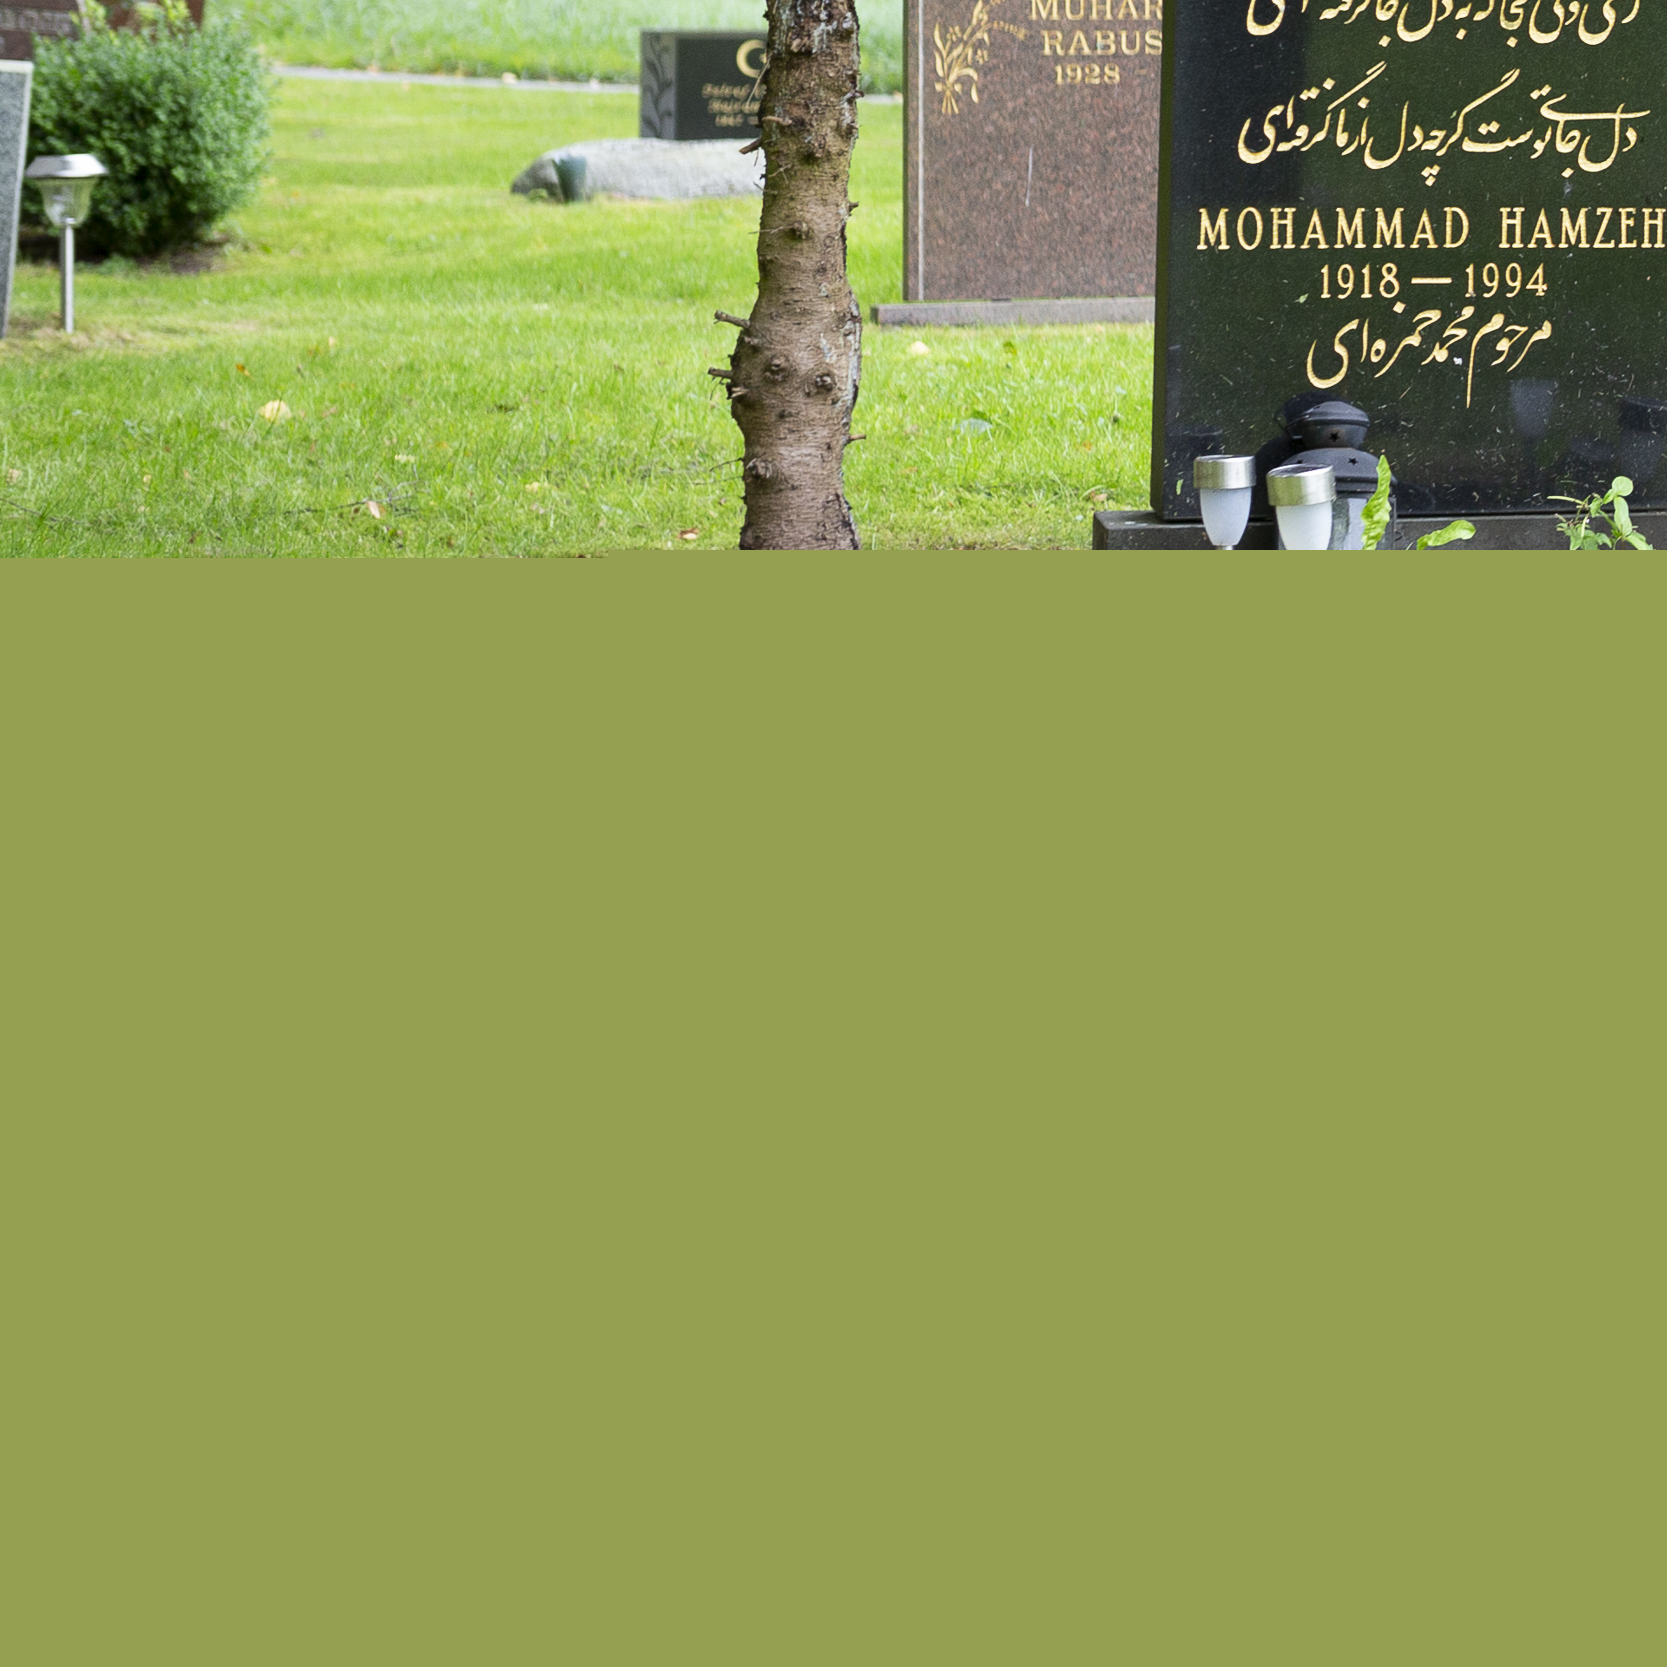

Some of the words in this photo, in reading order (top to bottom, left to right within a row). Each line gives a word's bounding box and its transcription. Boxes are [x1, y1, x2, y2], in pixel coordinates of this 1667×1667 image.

[1054, 63, 1120, 85] 1928
[1197, 207, 1469, 250] MOHAMMAD
[1499, 207, 1667, 249] HAMZEH
[1320, 262, 1400, 299] 1918
[1465, 262, 1548, 298] 1994
